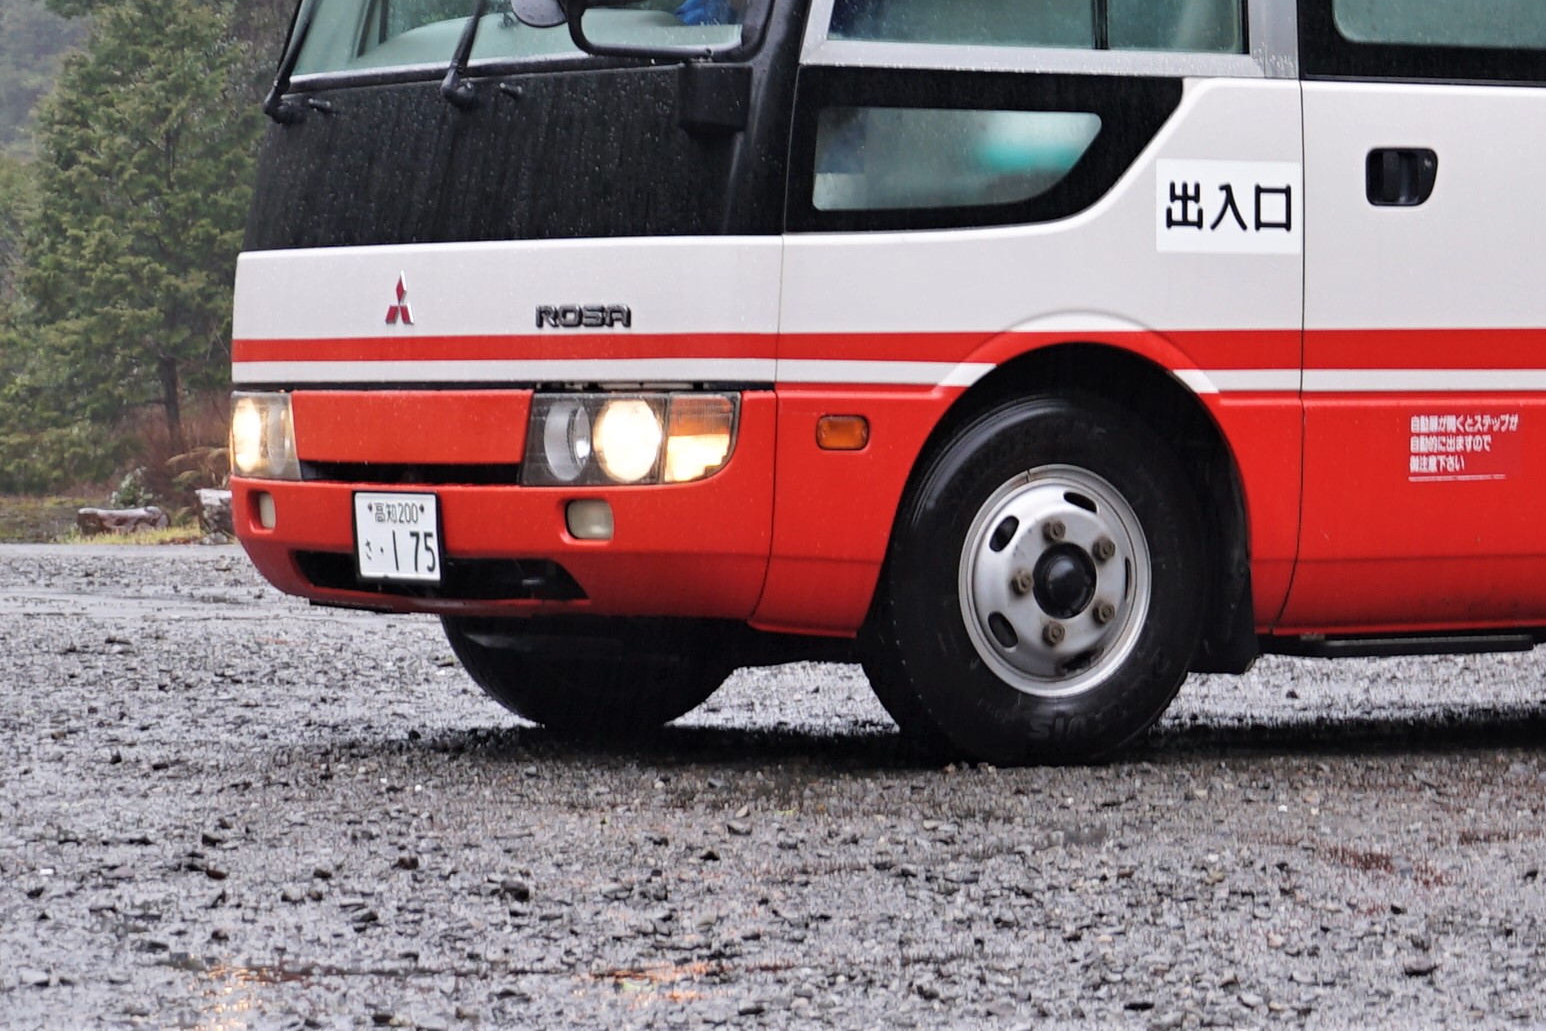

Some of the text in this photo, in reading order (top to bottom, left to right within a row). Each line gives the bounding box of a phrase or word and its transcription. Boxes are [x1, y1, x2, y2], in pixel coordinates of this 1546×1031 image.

[1165, 181, 1292, 232] 出入口
[535, 304, 632, 328] ROSA
[374, 502, 419, 523] 高知200
